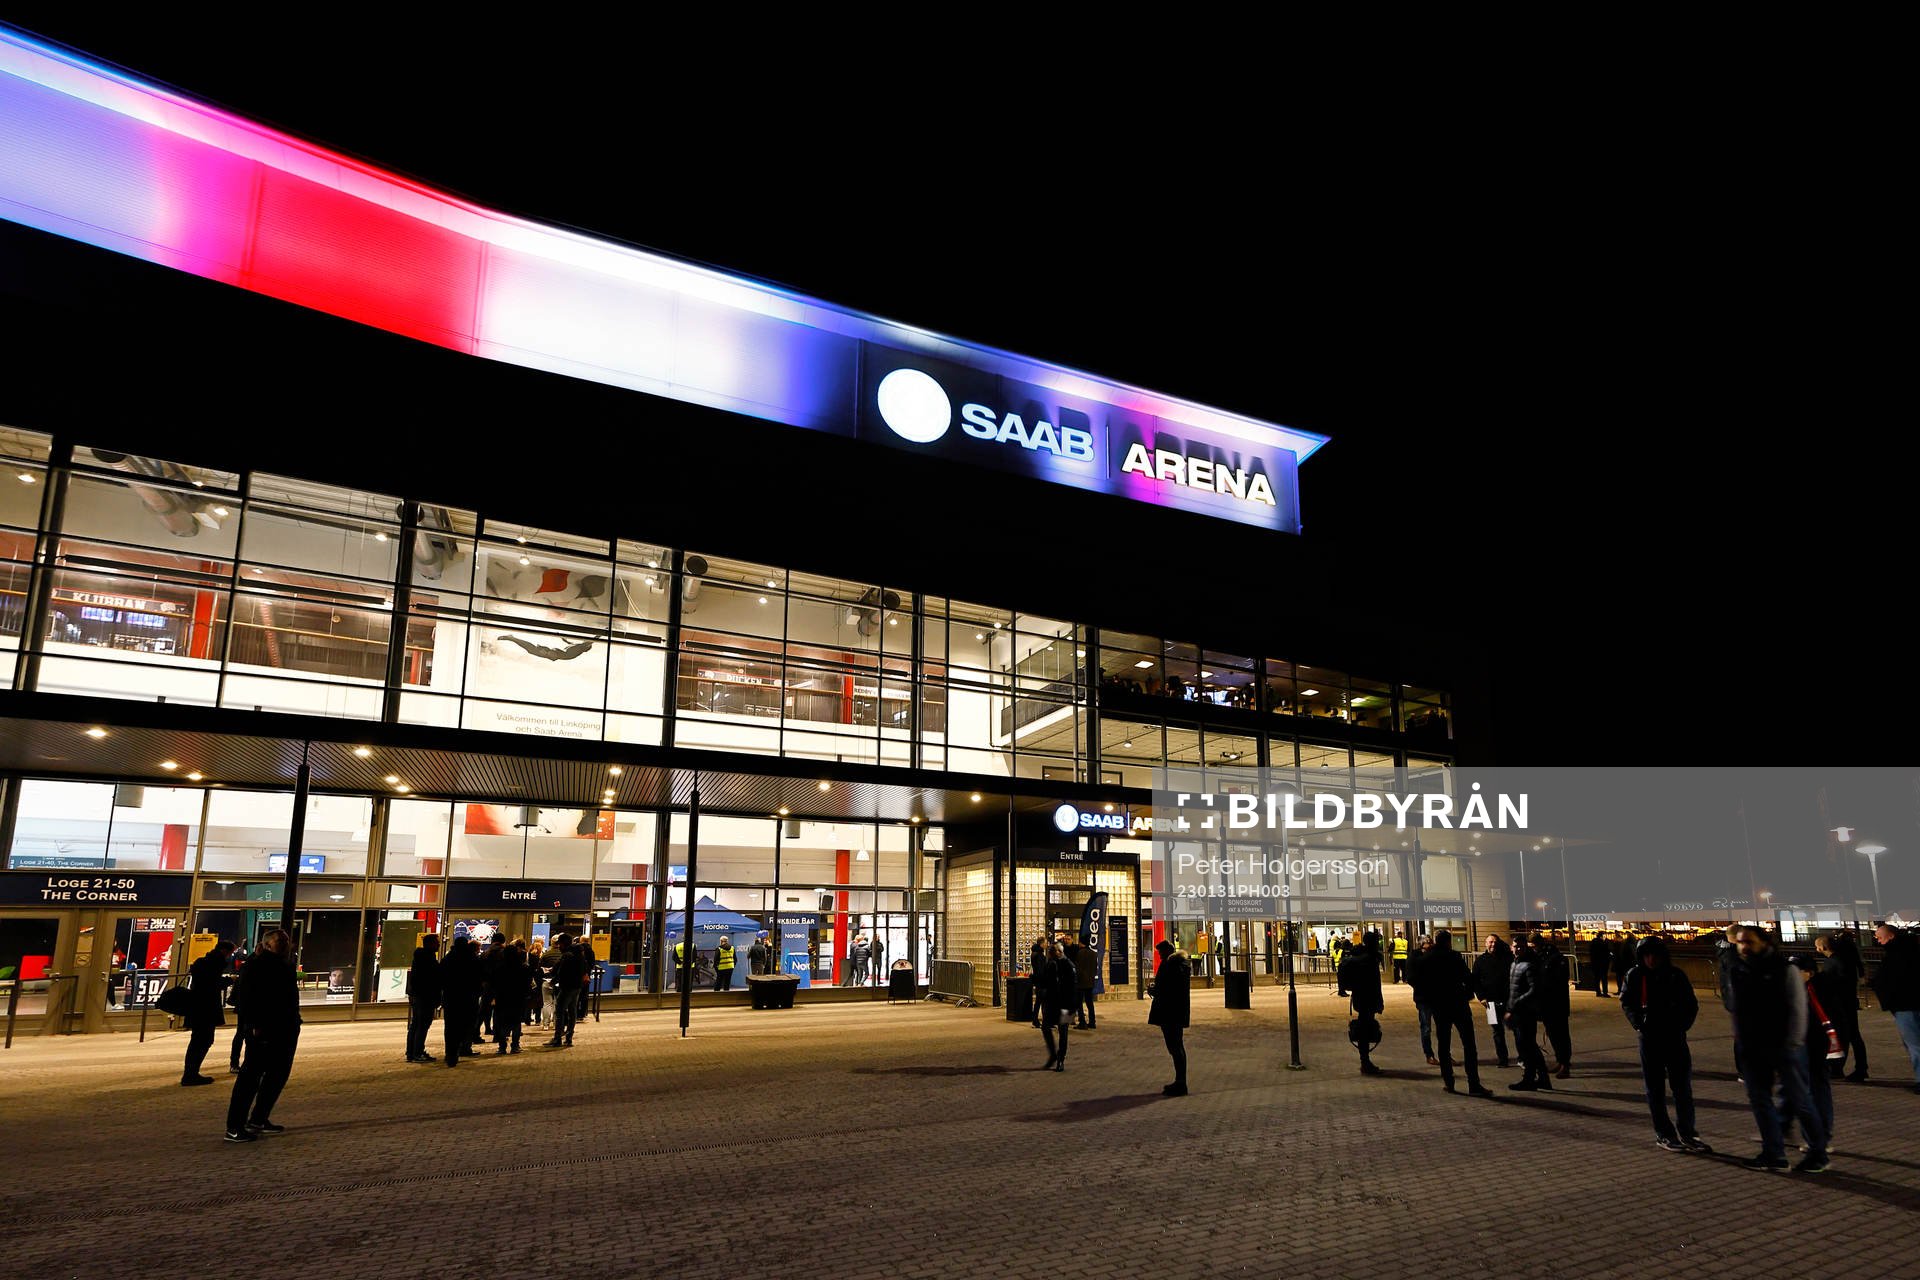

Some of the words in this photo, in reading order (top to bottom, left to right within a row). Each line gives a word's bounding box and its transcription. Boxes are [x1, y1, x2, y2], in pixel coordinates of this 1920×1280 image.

[961, 403, 1095, 463] SAAB
[1121, 443, 1277, 507] ARENA
[496, 712, 547, 726] Välkommen
[549, 718, 559, 726] till
[560, 719, 601, 731] Linköping
[515, 725, 532, 733] och
[534, 726, 557, 736] Saab
[558, 728, 583, 738] Arena
[1080, 813, 1125, 829] SAAB
[93, 878, 136, 889] 21-50
[41, 889, 72, 900] THE
[76, 890, 138, 901] CORNER
[1423, 905, 1463, 914] UNDCENTER
[769, 916, 800, 924] RNKSIDE
[1573, 914, 1608, 922] VOLVO
[703, 923, 729, 931] Nordea
